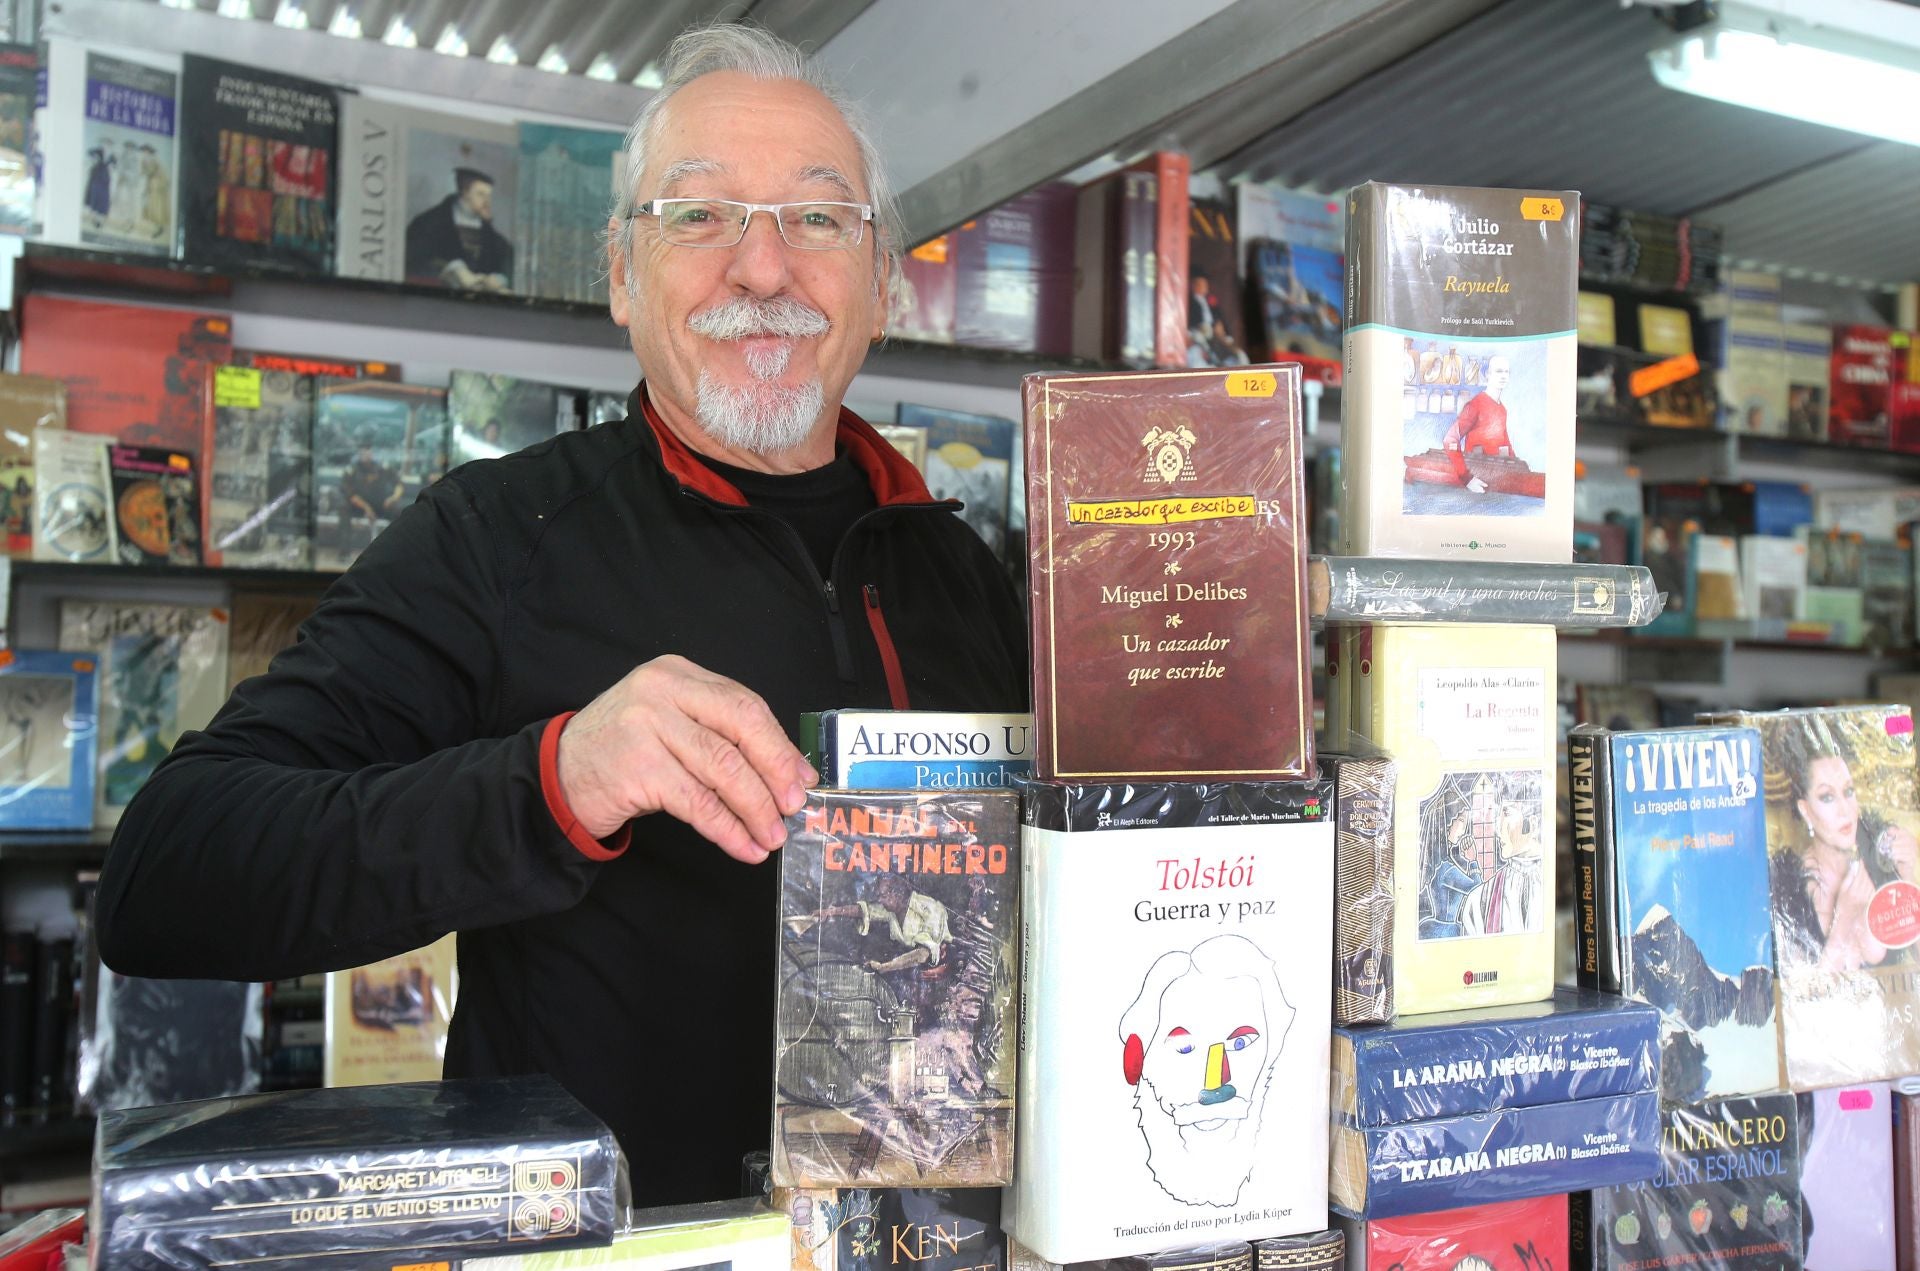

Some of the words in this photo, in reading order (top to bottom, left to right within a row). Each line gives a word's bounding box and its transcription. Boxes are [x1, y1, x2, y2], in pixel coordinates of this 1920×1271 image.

[1457, 217, 1500, 236] Julio
[1443, 237, 1514, 256] Cortázar
[1443, 275, 1510, 297] Rayuela
[1440, 317, 1463, 326] Prólogo
[1463, 317, 1470, 325] de
[1149, 532, 1195, 551] 1993
[1100, 584, 1168, 609] Miguel
[1175, 582, 1247, 602] Delibes
[1382, 570, 1418, 599] Las
[1422, 576, 1454, 597] mil
[1456, 586, 1468, 608] y
[1472, 586, 1503, 601] una
[1508, 581, 1558, 602] noches
[1122, 634, 1151, 654] Un
[1157, 632, 1230, 652] cazador
[1127, 664, 1161, 687] que
[1165, 659, 1226, 680] escribe
[1480, 677, 1500, 688] Alas
[1466, 703, 1482, 718] La
[849, 725, 991, 756] ALFONSO
[914, 765, 1031, 787] Pachuch
[1625, 738, 1751, 794] ¡VIVEN!
[1572, 745, 1597, 853] ¡VIVEN!
[1634, 801, 1646, 815] La
[1648, 798, 1687, 816] tragedia
[1690, 796, 1701, 811] de
[1703, 795, 1717, 809] los
[1718, 794, 1746, 809] Andes
[805, 805, 938, 838] MANUAL
[1113, 819, 1120, 827] El
[1121, 818, 1135, 828] Aleph
[1136, 818, 1159, 826] Editores
[1208, 815, 1219, 823] del
[1220, 814, 1241, 823] Taller
[1251, 813, 1270, 822] Mario
[1271, 811, 1301, 821] Muchnik
[1683, 833, 1706, 850] Paul
[825, 843, 1008, 875] CANTINERO
[1157, 856, 1255, 892] Tolstói
[1582, 866, 1593, 900] Read
[1134, 901, 1211, 923] Guerra
[1217, 901, 1232, 924] y
[1238, 899, 1276, 924] paz
[1584, 905, 1595, 934] Paul
[1585, 937, 1596, 973] Piers
[1570, 1058, 1599, 1072] Blasco
[1600, 1056, 1630, 1069] Ibáñez
[1583, 1046, 1618, 1058] Vicente
[1394, 1066, 1418, 1088] LA
[1421, 1059, 1486, 1086] ARAÑA
[1491, 1053, 1553, 1077] NEGRA
[1571, 1146, 1600, 1160] Blasco
[1600, 1141, 1631, 1156] Ibáñez
[1583, 1132, 1618, 1145] Vicente
[1401, 1160, 1424, 1183] LA
[1427, 1149, 1491, 1180] ARAÑA
[1497, 1142, 1556, 1167] NEGRA
[1706, 1148, 1788, 1184] ESPAÑOL
[338, 1171, 426, 1193] MARGARET
[428, 1166, 500, 1187] MITCHELL
[291, 1208, 312, 1225] LO
[314, 1205, 347, 1223] QUE
[352, 1204, 372, 1220] EL
[371, 1199, 427, 1218] VIENTO
[427, 1198, 450, 1214] SE
[1113, 1223, 1171, 1238] Traducción
[1173, 1220, 1188, 1230] del
[1191, 1220, 1212, 1228] ruso
[1215, 1218, 1231, 1228] por
[1234, 1210, 1260, 1225] Lydia
[1262, 1206, 1293, 1221] Kúper
[891, 1221, 960, 1264] KEN
